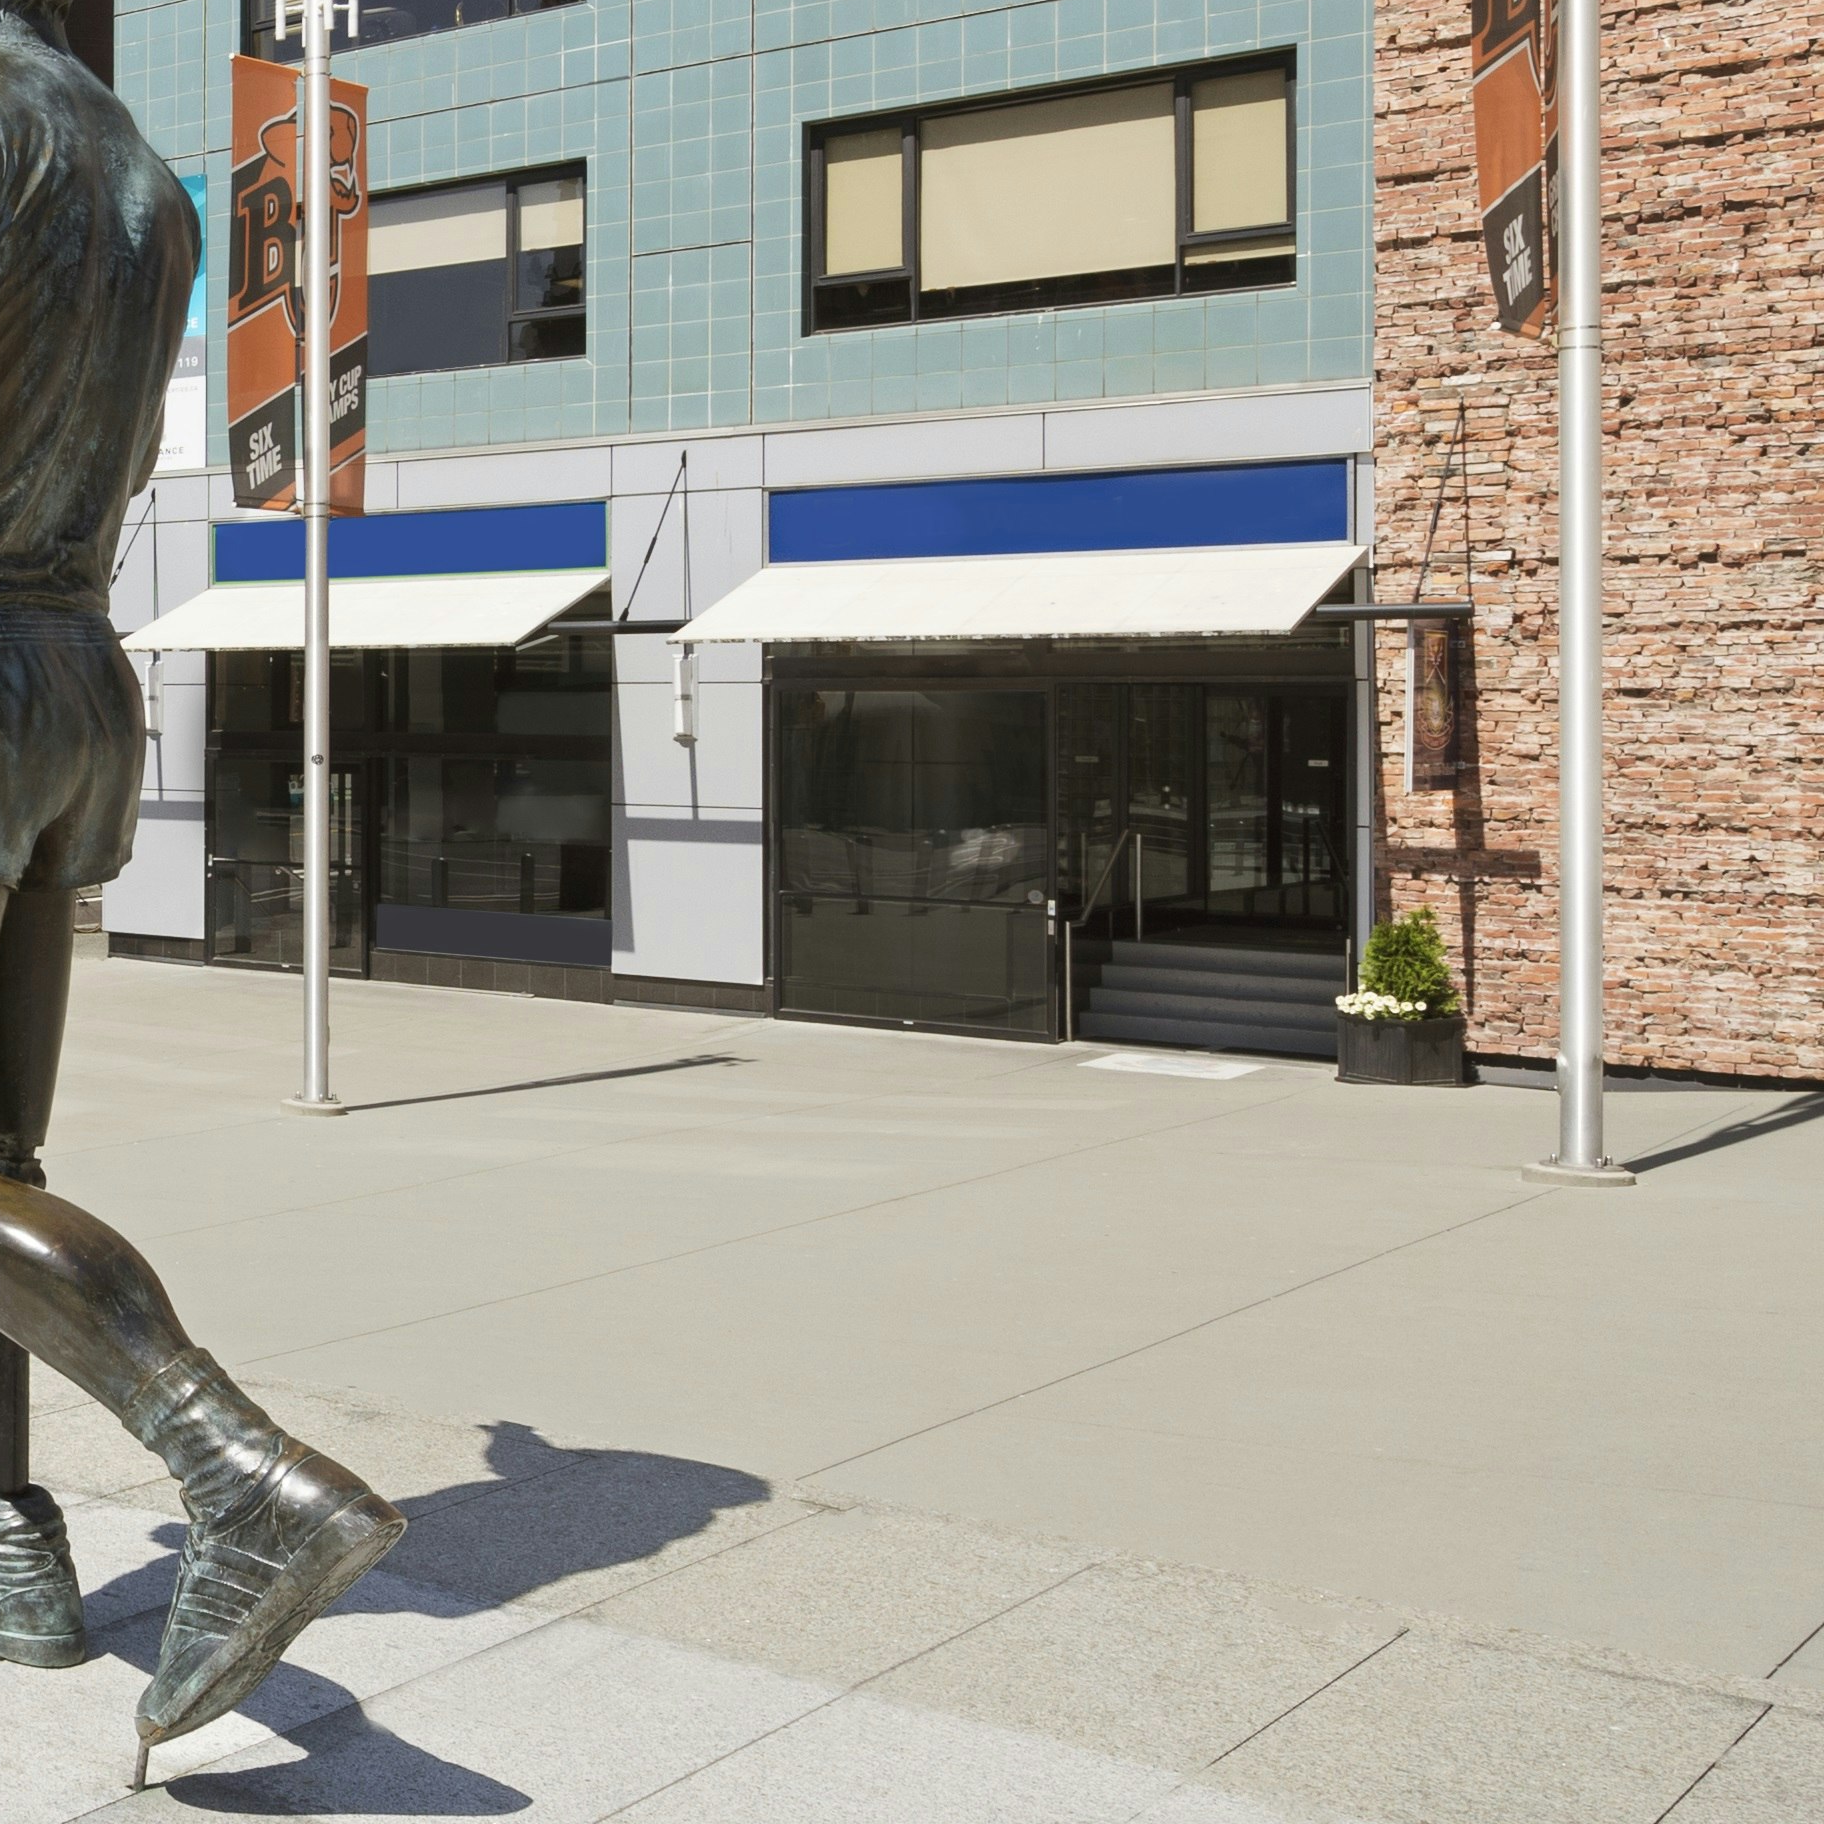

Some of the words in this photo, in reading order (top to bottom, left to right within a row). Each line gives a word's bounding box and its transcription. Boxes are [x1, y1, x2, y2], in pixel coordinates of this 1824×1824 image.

[1503, 213, 1525, 265] SIX
[1503, 246, 1533, 307] TIME
[178, 356, 199, 369] 119
[339, 364, 362, 396] CUP
[329, 388, 359, 424] AMPS
[159, 447, 184, 456] ANCE
[249, 421, 274, 461] SIX
[246, 444, 283, 490] TIME
